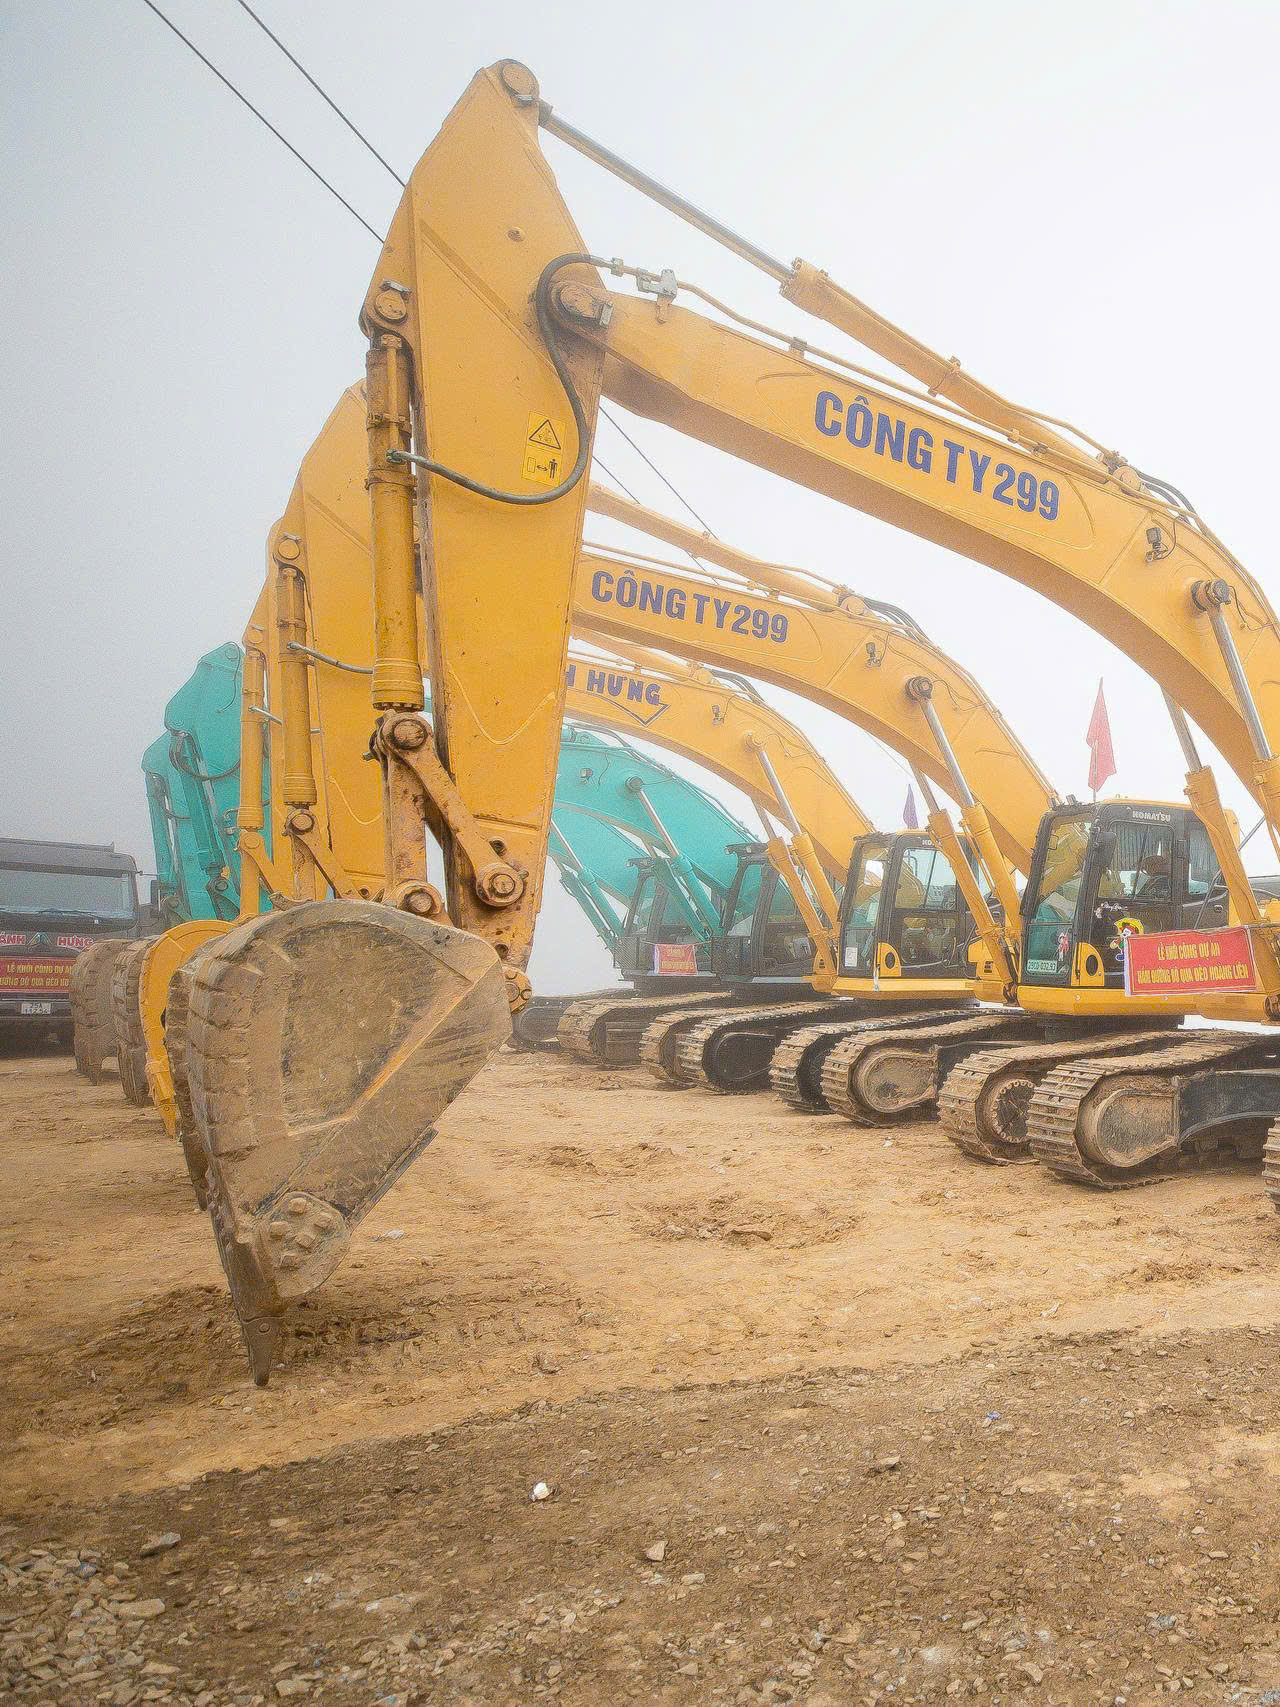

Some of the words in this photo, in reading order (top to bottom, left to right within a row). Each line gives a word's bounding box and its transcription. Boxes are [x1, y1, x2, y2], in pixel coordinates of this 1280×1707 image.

[815, 390, 934, 474] CÔNG
[592, 569, 687, 620] CÔNG
[586, 669, 661, 706] HƯNG
[1132, 810, 1171, 822] KOMATSU
